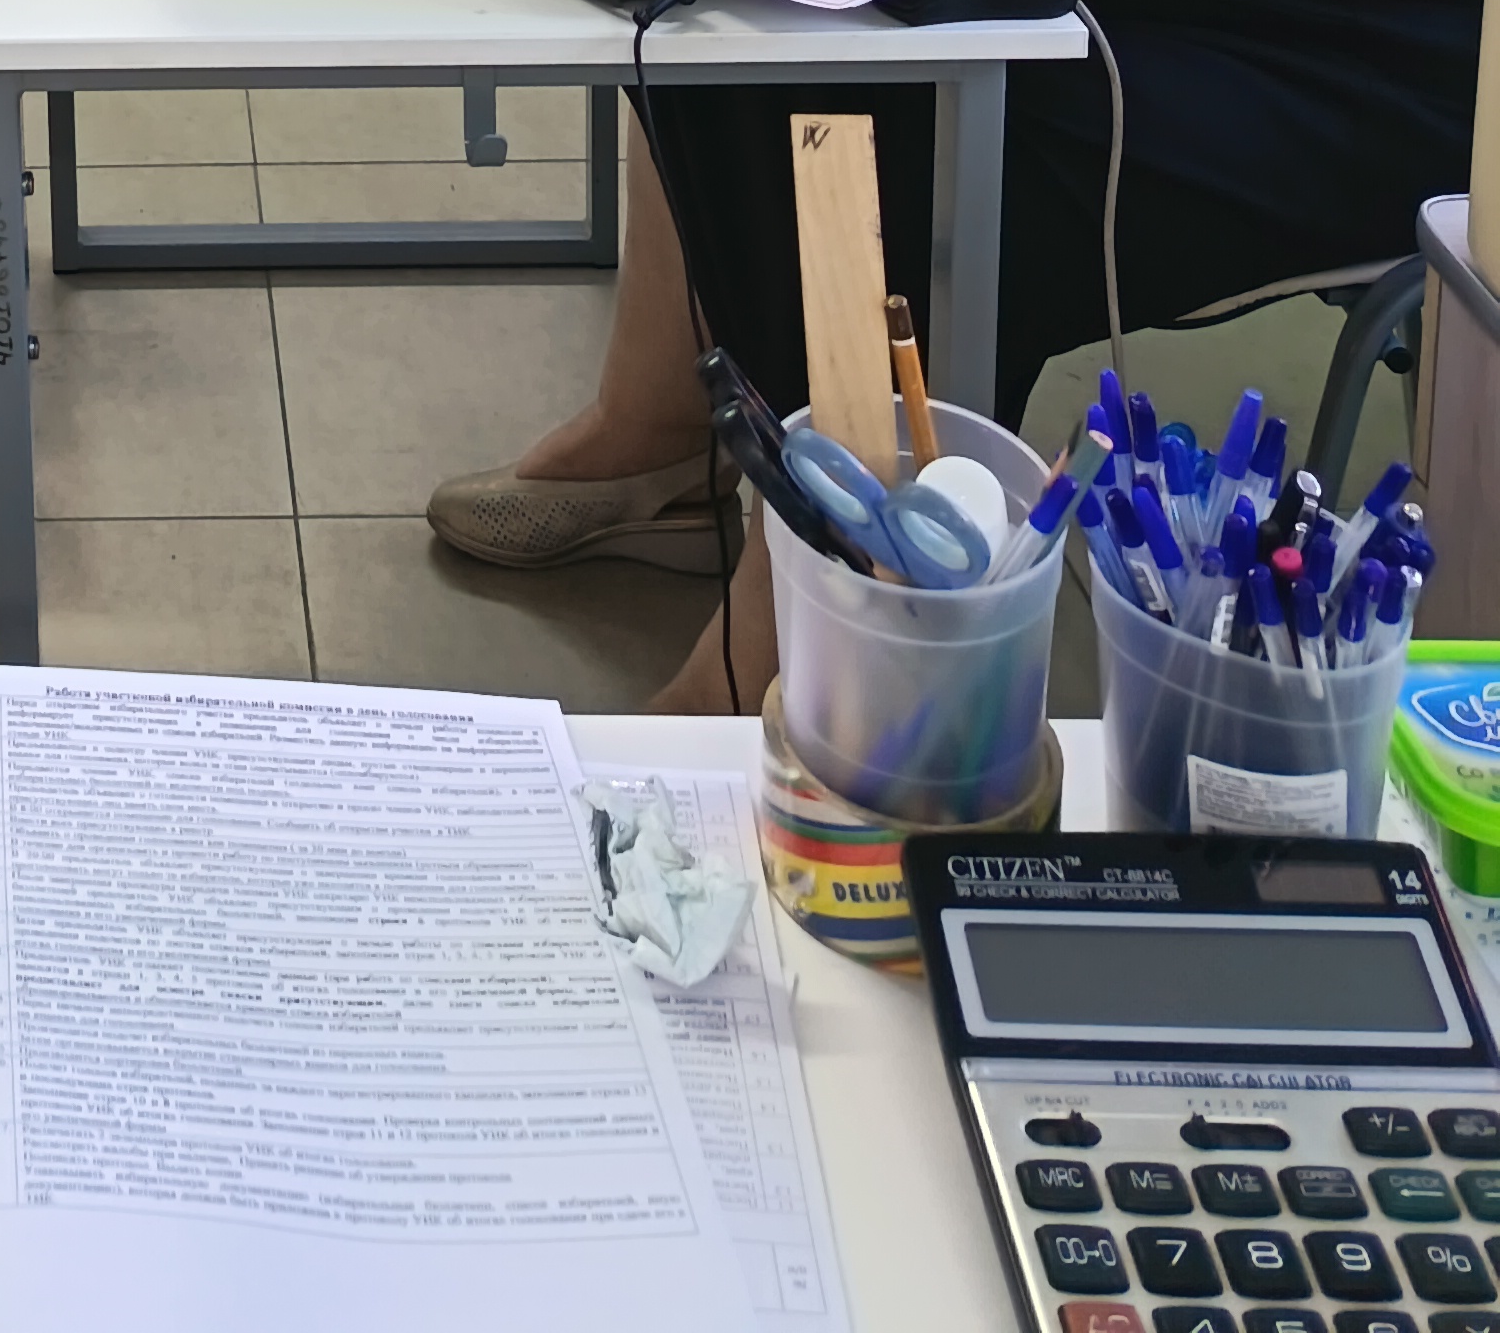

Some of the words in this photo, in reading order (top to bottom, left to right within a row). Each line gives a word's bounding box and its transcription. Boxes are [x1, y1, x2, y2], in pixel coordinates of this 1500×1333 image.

[948, 855, 1065, 881] CITIZEN
[1389, 870, 1421, 891] 14
[1038, 1167, 1084, 1189] MRC
[1156, 1239, 1188, 1267] 7
[1247, 1241, 1284, 1269] 8
[1336, 1243, 1372, 1272] 9
[1427, 1246, 1472, 1273] %
